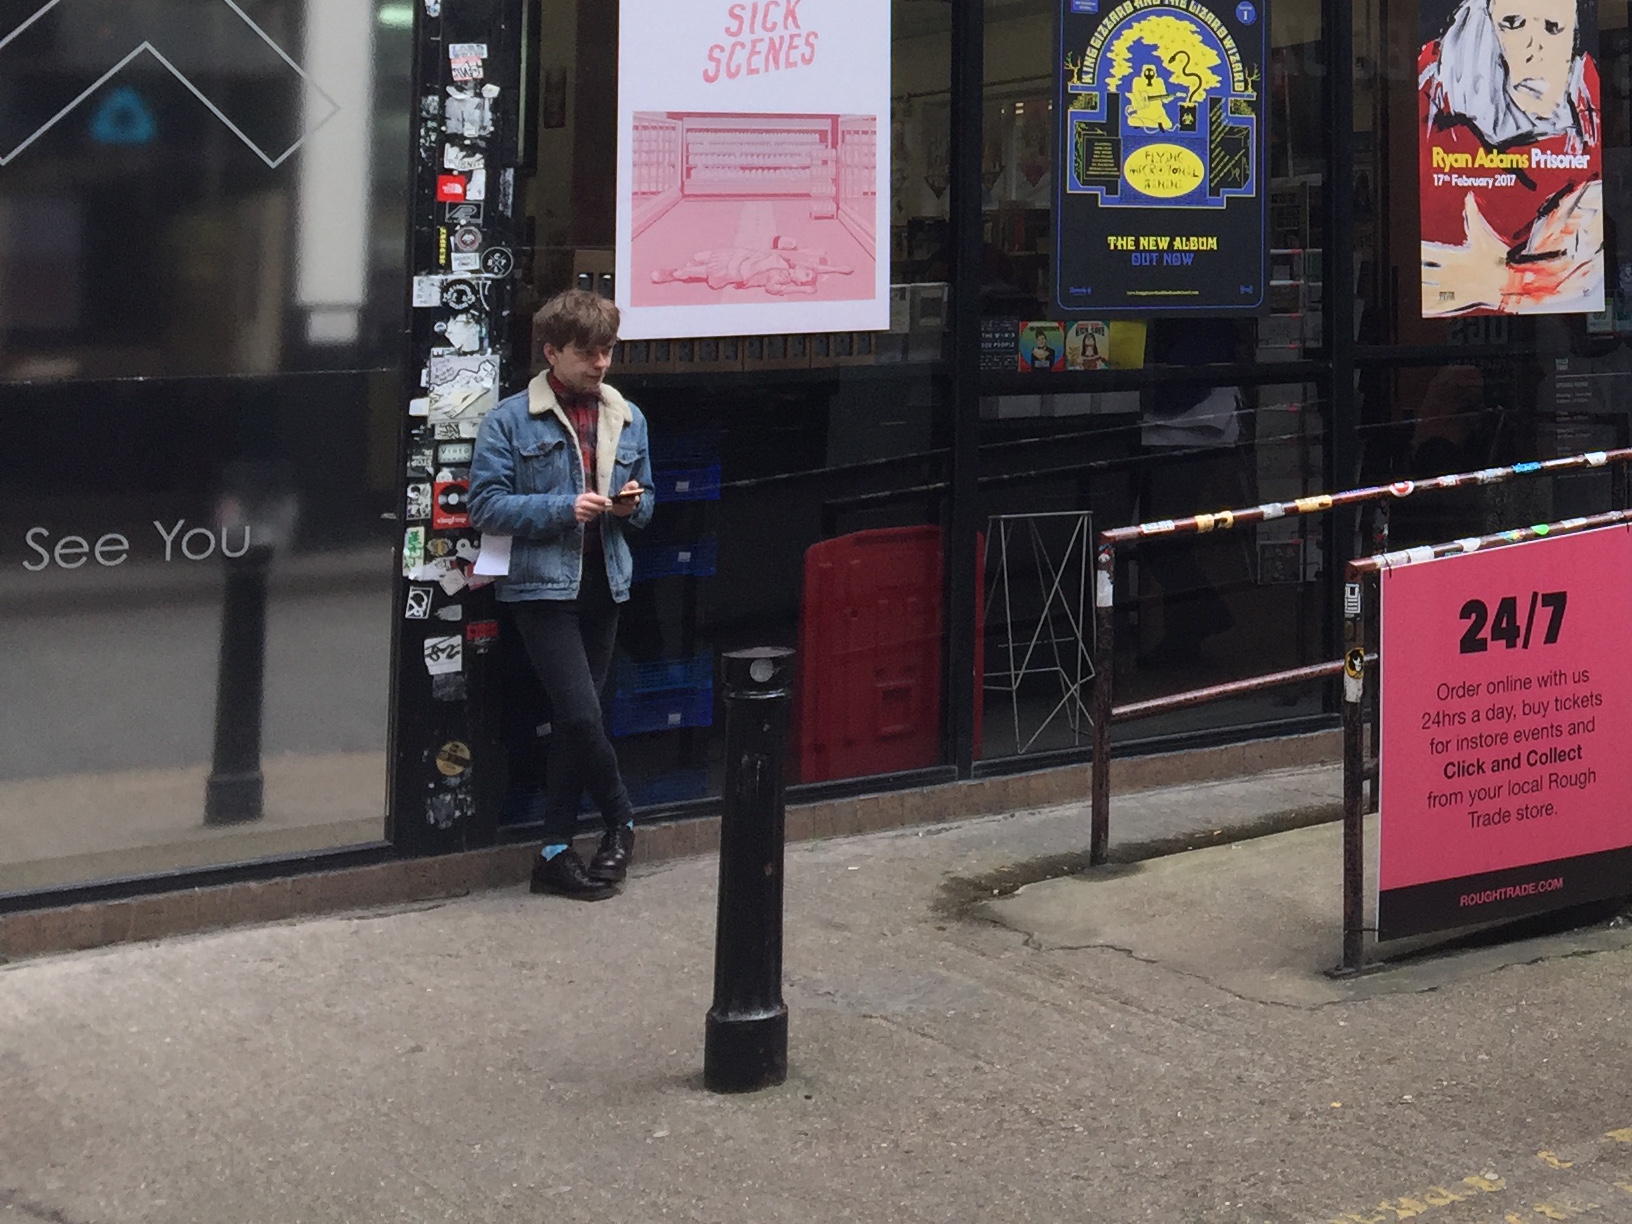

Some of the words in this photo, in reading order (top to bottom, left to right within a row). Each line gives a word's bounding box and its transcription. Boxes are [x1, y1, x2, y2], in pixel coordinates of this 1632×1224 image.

[702, 30, 819, 83] SCENES
[1081, 46, 1098, 84] KING
[1090, 1, 1134, 50] GIZZARD
[1223, 36, 1245, 91] WIZARD
[1432, 146, 1473, 173] Ryan
[1476, 147, 1529, 170] Adams
[1530, 147, 1591, 170] Prisoner
[1451, 174, 1494, 189] February
[1494, 174, 1516, 187] 2017
[1107, 236, 1136, 251] THE
[1139, 236, 1170, 251] NEW
[1173, 236, 1218, 251] ALBUM
[1131, 252, 1159, 266] OUT
[1163, 252, 1195, 266] NOW
[22, 526, 130, 572] See
[153, 518, 251, 562] You
[1459, 590, 1568, 655] 24/7
[1436, 681, 1482, 702] Order
[1486, 674, 1533, 695] online
[1537, 668, 1568, 688] with
[1572, 669, 1590, 684] us
[1421, 708, 1467, 730] 24hrs
[1471, 708, 1481, 724] a
[1485, 701, 1517, 724] day,
[1521, 696, 1550, 721] buy
[1554, 690, 1603, 712] tickets
[1429, 737, 1452, 755] for
[1456, 727, 1509, 752] instore
[1513, 721, 1564, 743] events
[1567, 716, 1596, 737] and
[1443, 755, 1486, 780] Click
[1490, 752, 1522, 773] and
[1526, 744, 1583, 768] Collect
[1427, 789, 1464, 809] from
[1468, 784, 1503, 808] your
[1507, 776, 1544, 797] local
[1548, 767, 1597, 793] Rough
[1467, 806, 1512, 830] Trade
[1515, 802, 1559, 822] store.
[1460, 876, 1564, 908] ROUGHTRADE.COM
